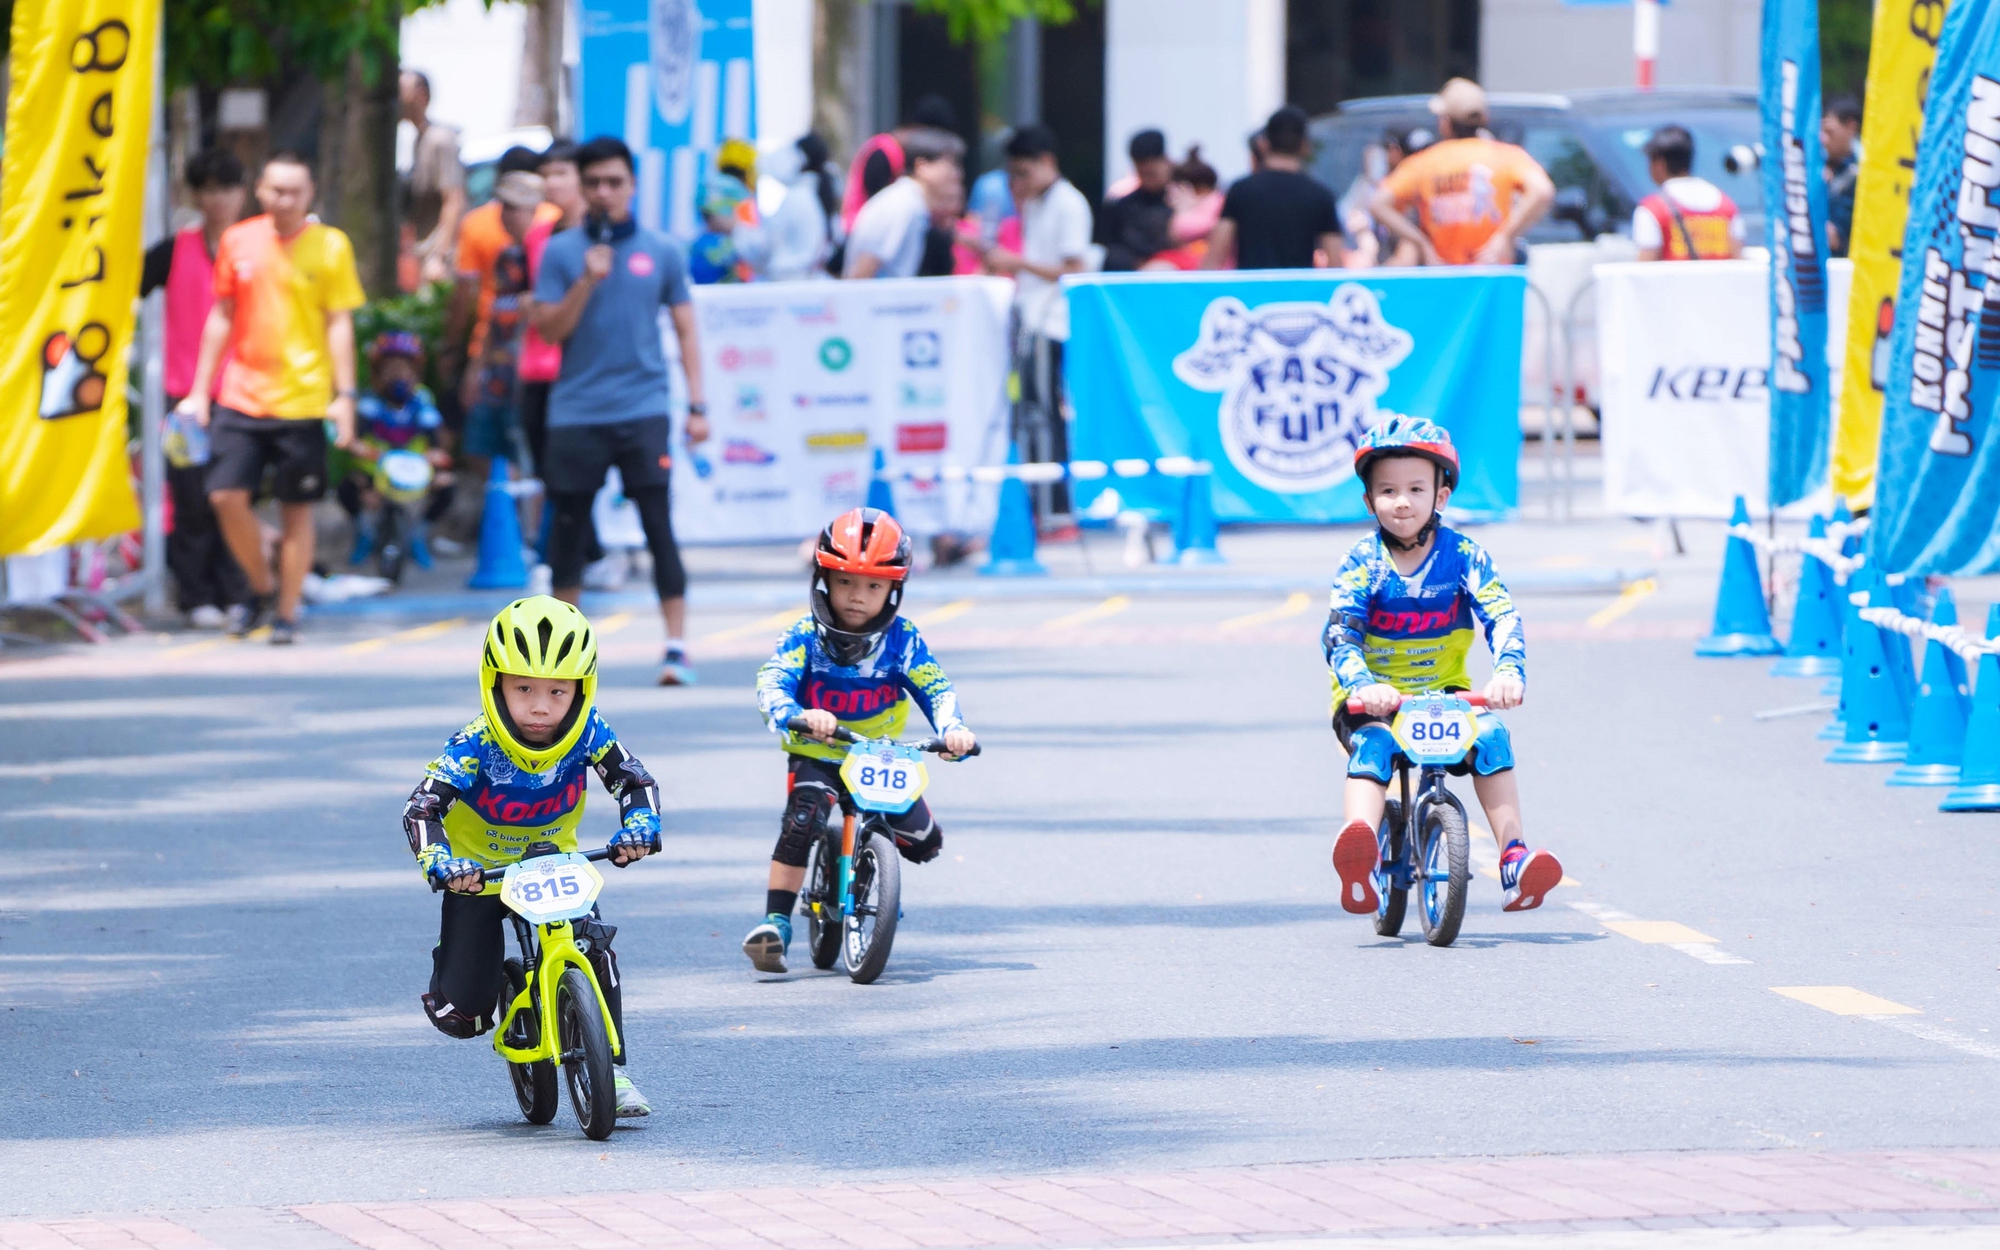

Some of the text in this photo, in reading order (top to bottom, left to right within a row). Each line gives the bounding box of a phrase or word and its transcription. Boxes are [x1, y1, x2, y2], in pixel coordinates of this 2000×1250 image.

[1910, 246, 1951, 413] KONNIT
[1251, 356, 1372, 395] FAST
[1929, 270, 1985, 457] FAST
[1412, 722, 1460, 740] 804
[860, 766, 907, 790] 818
[523, 876, 579, 902] 815
